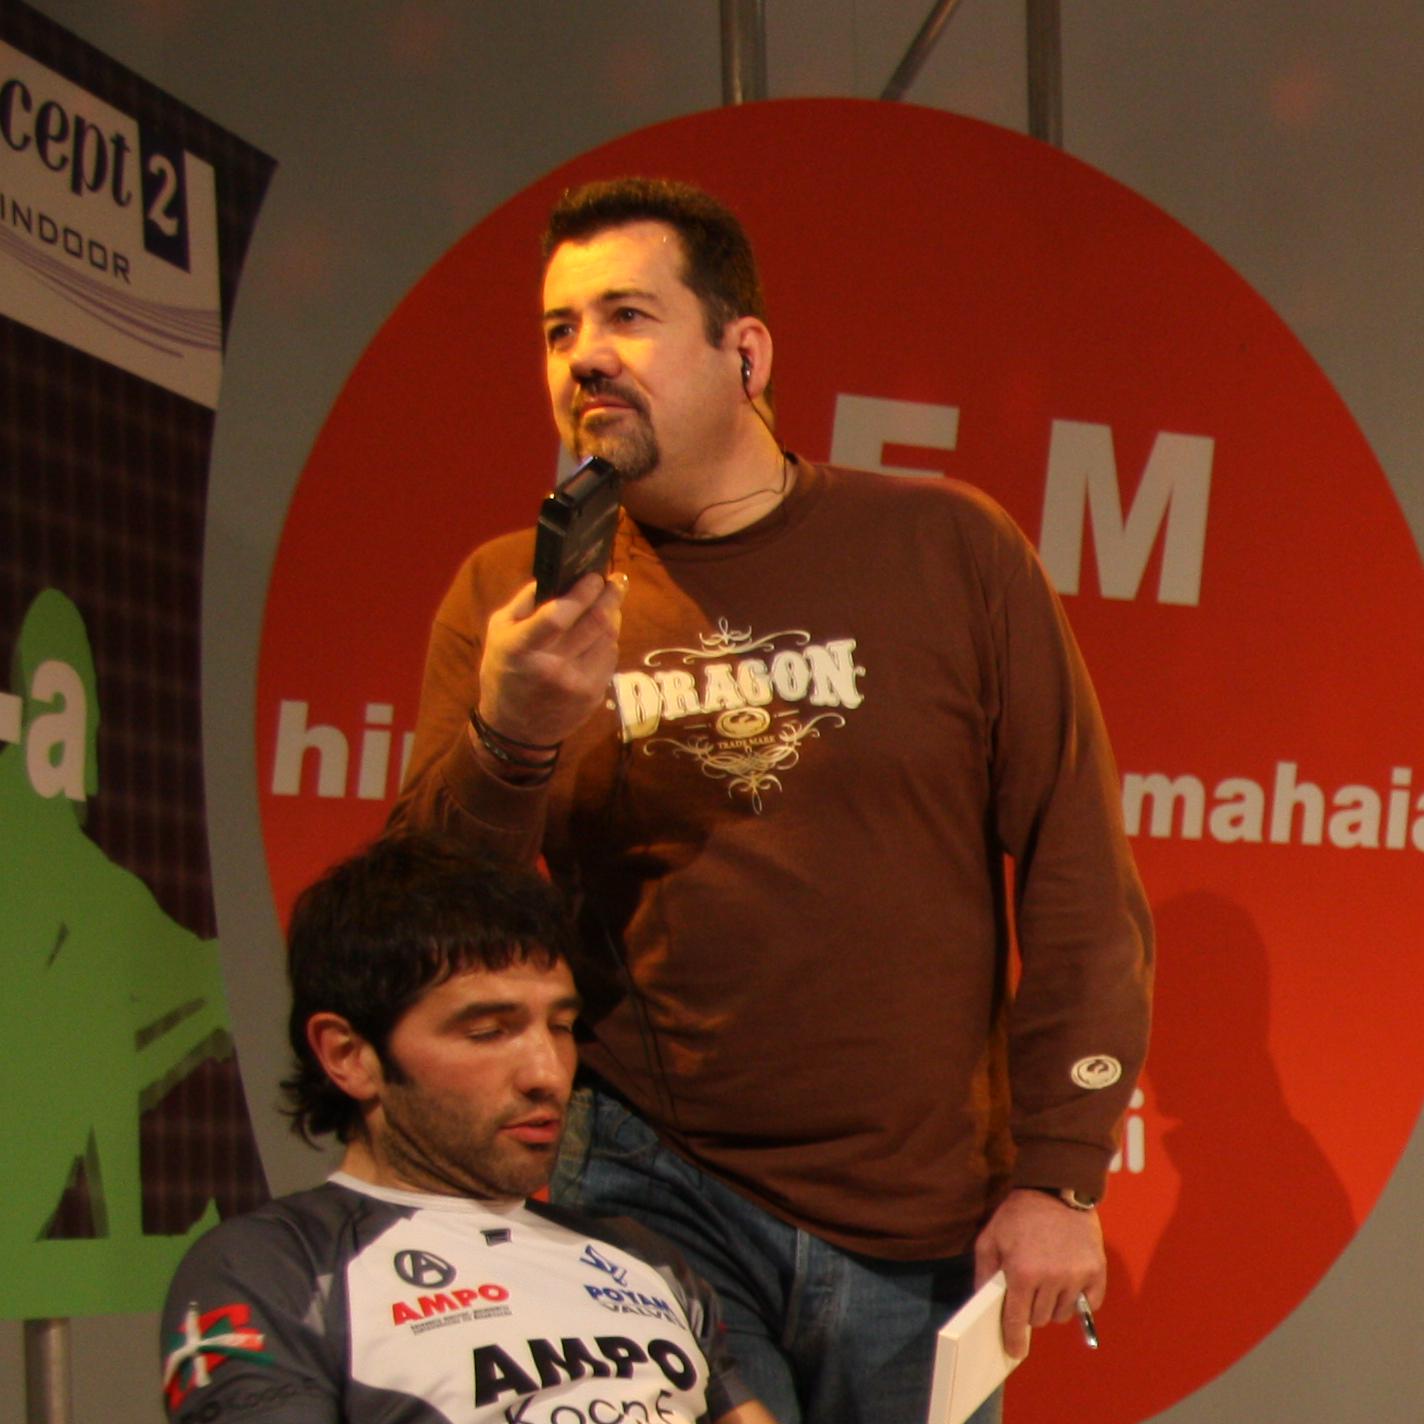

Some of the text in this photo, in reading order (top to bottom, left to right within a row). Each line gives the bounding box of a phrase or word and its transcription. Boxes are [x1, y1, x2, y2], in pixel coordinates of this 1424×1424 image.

[149, 153, 179, 237] 2
[612, 638, 864, 744] DRAGON
[392, 1284, 510, 1326] AMPO
[472, 1336, 698, 1409] AMPO
